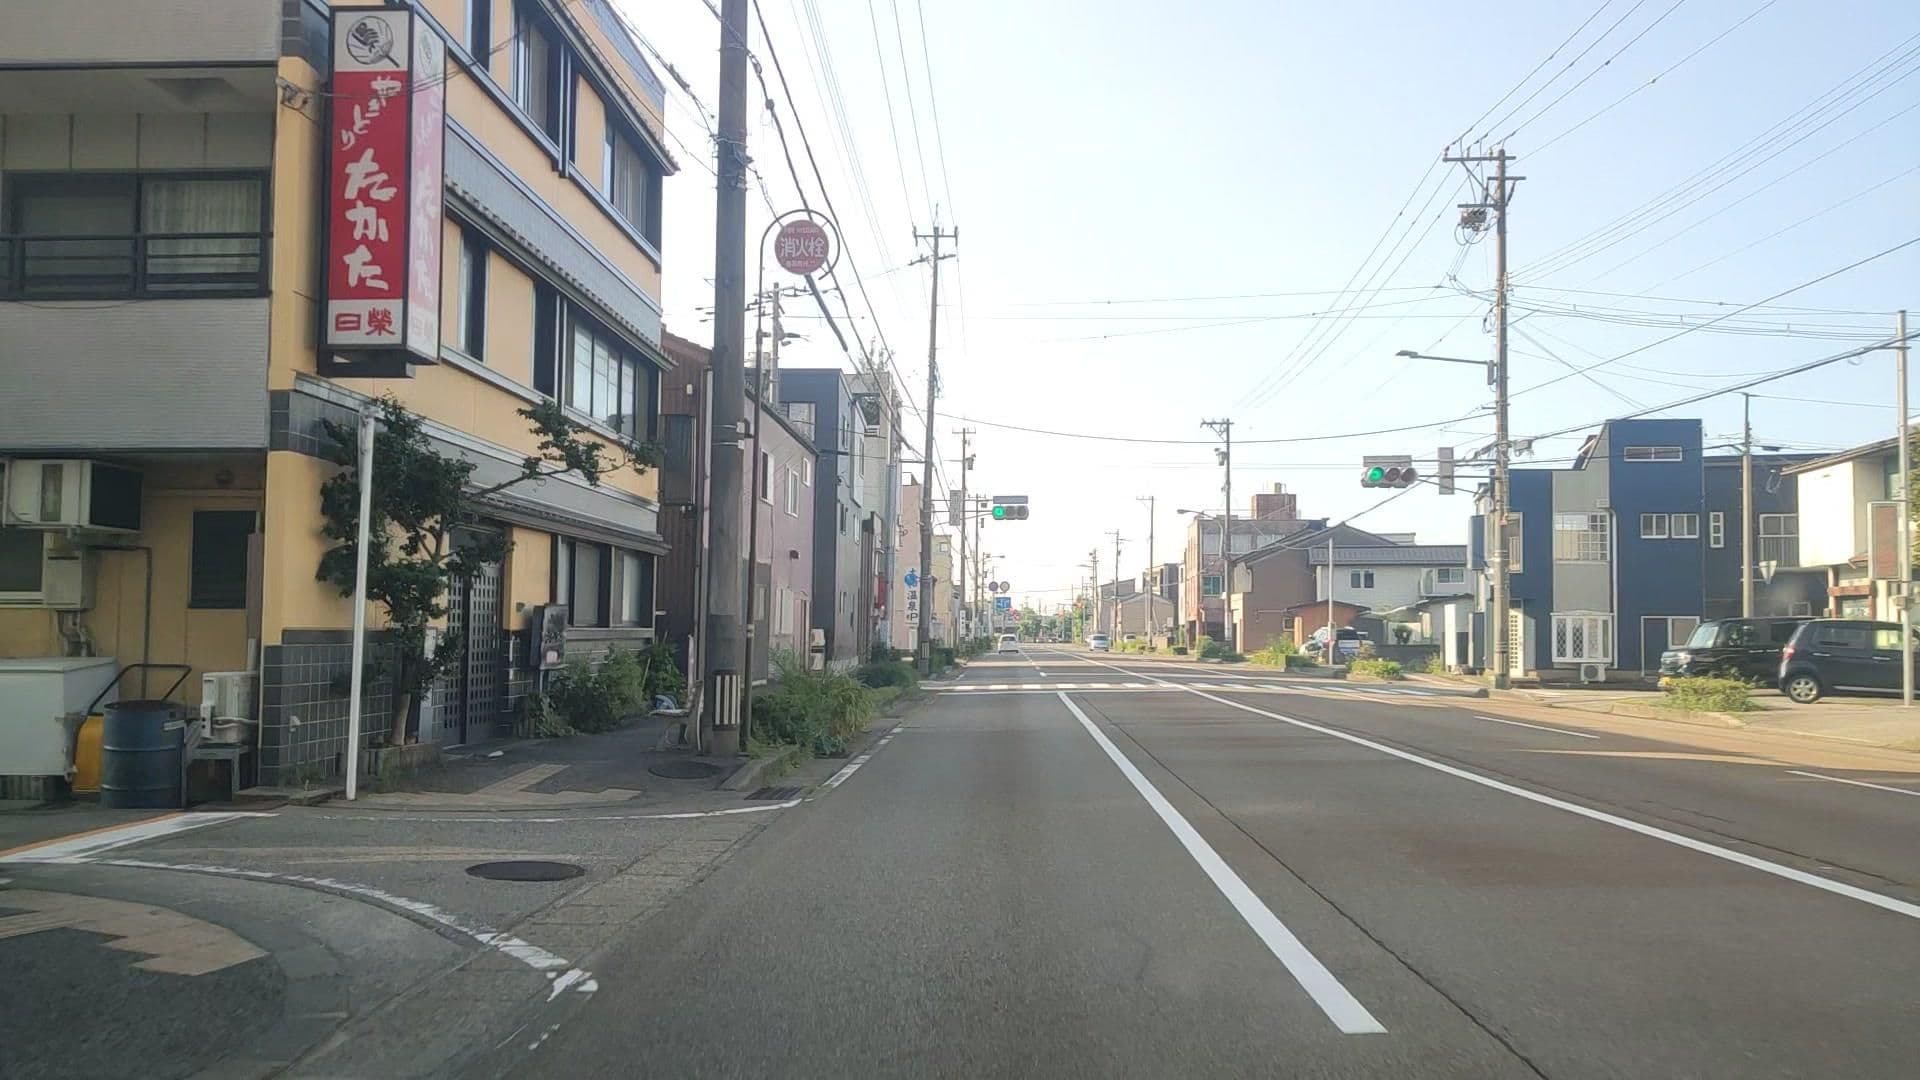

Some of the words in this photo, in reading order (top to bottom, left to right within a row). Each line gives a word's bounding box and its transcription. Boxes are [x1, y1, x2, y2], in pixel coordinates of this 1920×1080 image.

[343, 148, 397, 291] たかた
[780, 236, 824, 258] 消火栓
